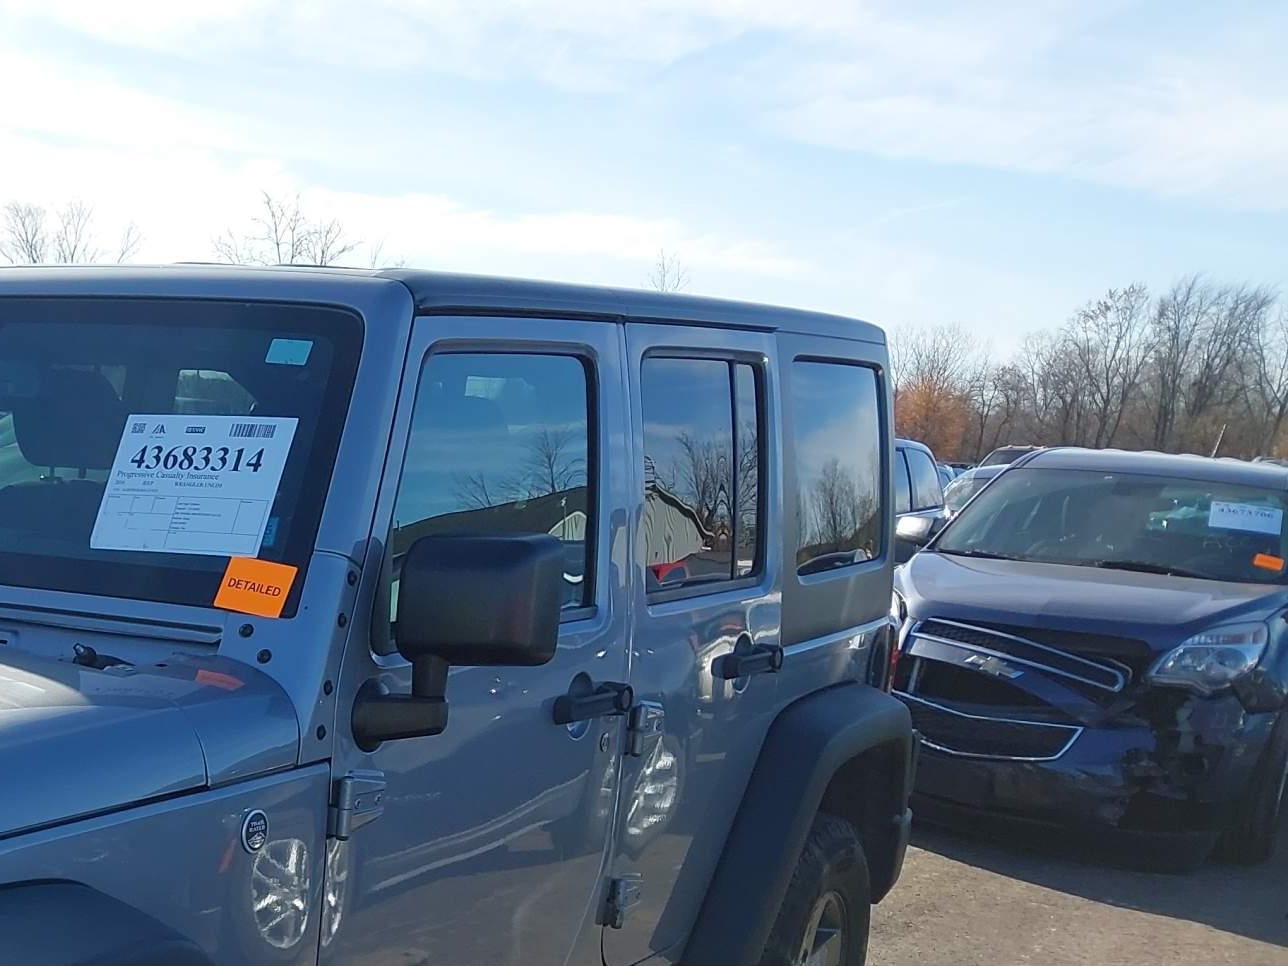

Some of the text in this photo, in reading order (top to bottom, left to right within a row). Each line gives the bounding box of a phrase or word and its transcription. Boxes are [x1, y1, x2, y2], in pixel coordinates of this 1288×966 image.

[130, 445, 265, 472] 43683314
[156, 471, 184, 481] Casualty
[186, 472, 220, 480] Insurance
[227, 577, 281, 598] DETAILED
